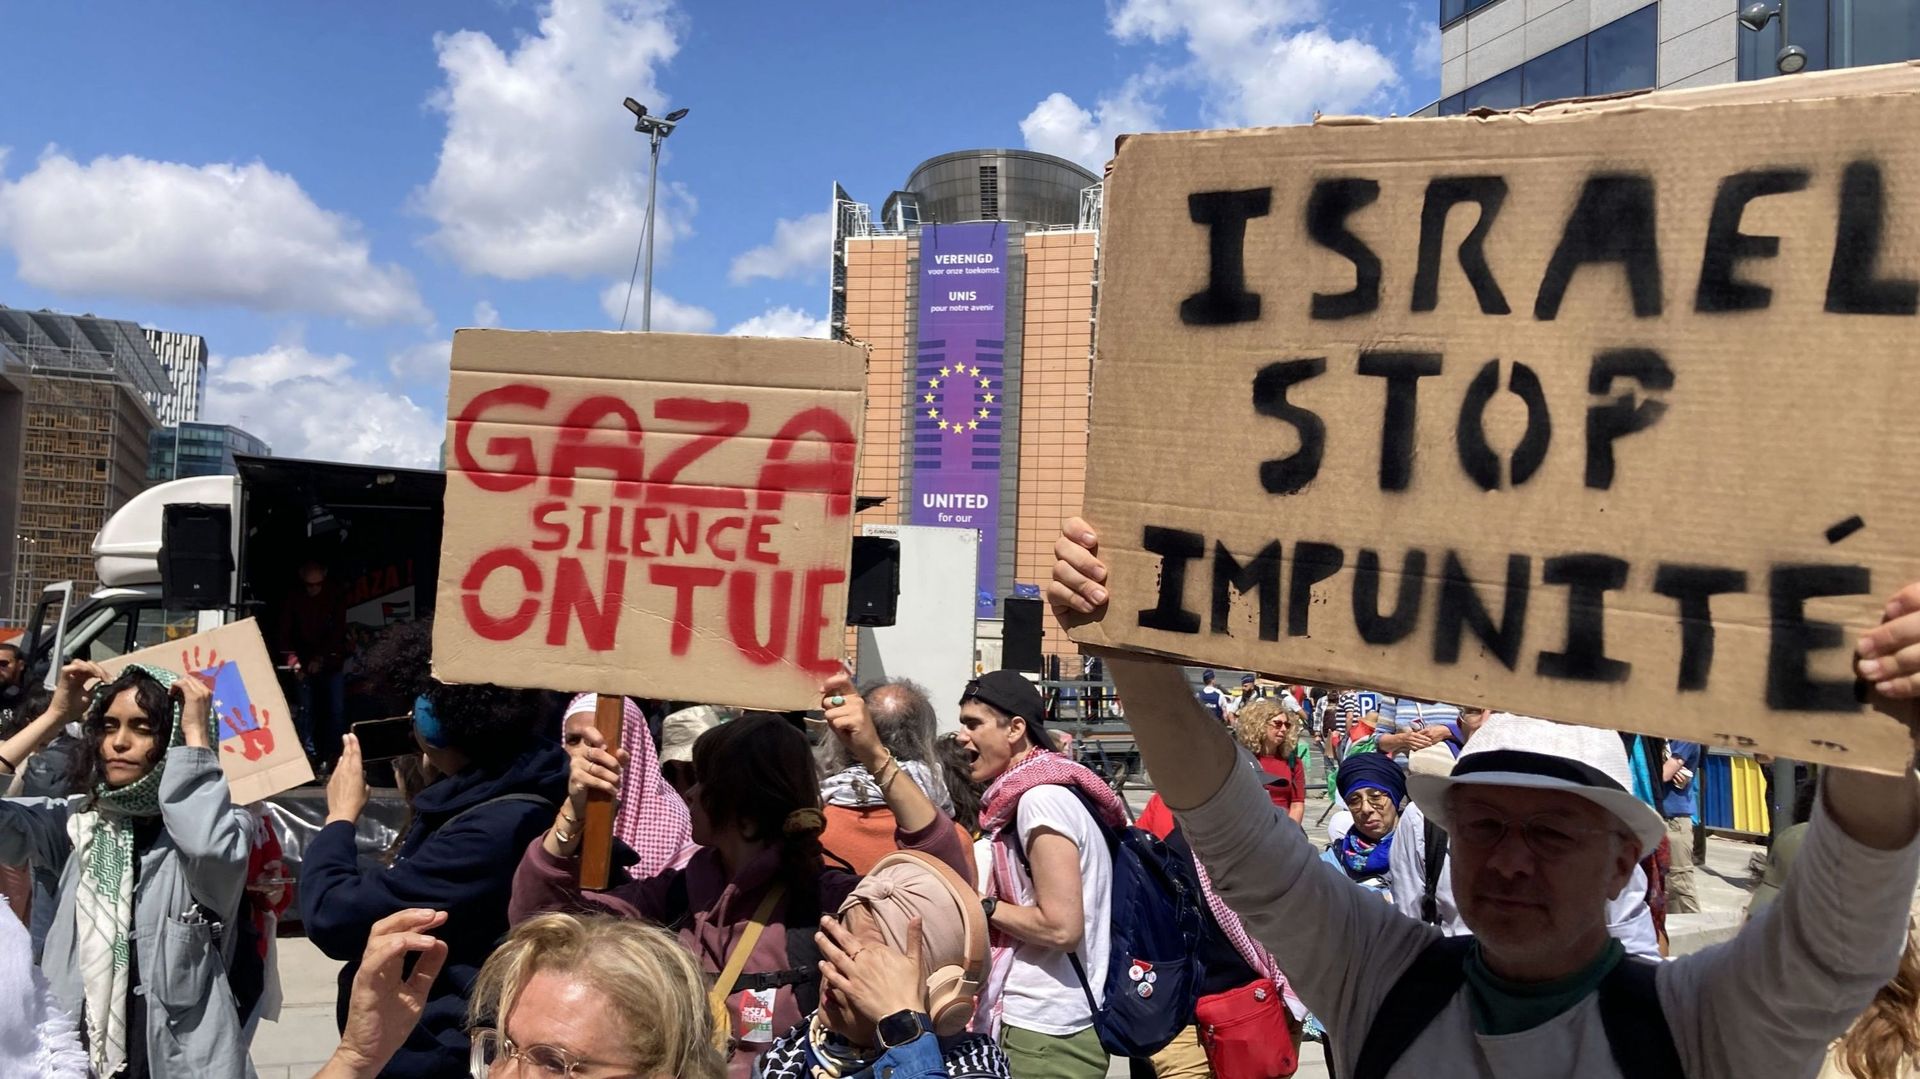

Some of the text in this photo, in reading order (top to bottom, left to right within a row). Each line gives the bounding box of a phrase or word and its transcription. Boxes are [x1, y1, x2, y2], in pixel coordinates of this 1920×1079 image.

[935, 254, 993, 264] VERENIGD
[1179, 159, 1920, 325] ISRAEL
[930, 305, 947, 313] pour
[948, 291, 977, 301] UNIS
[1252, 347, 1676, 494] STOP
[454, 384, 855, 516] GAZA
[923, 493, 988, 509] UNITED
[938, 513, 972, 523] for our
[532, 502, 782, 565] SILENCE
[346, 563, 400, 606] AZA
[461, 548, 846, 674] ON TUE
[1138, 514, 1870, 711] IMPUNITÉ
[1361, 697, 1373, 717] P
